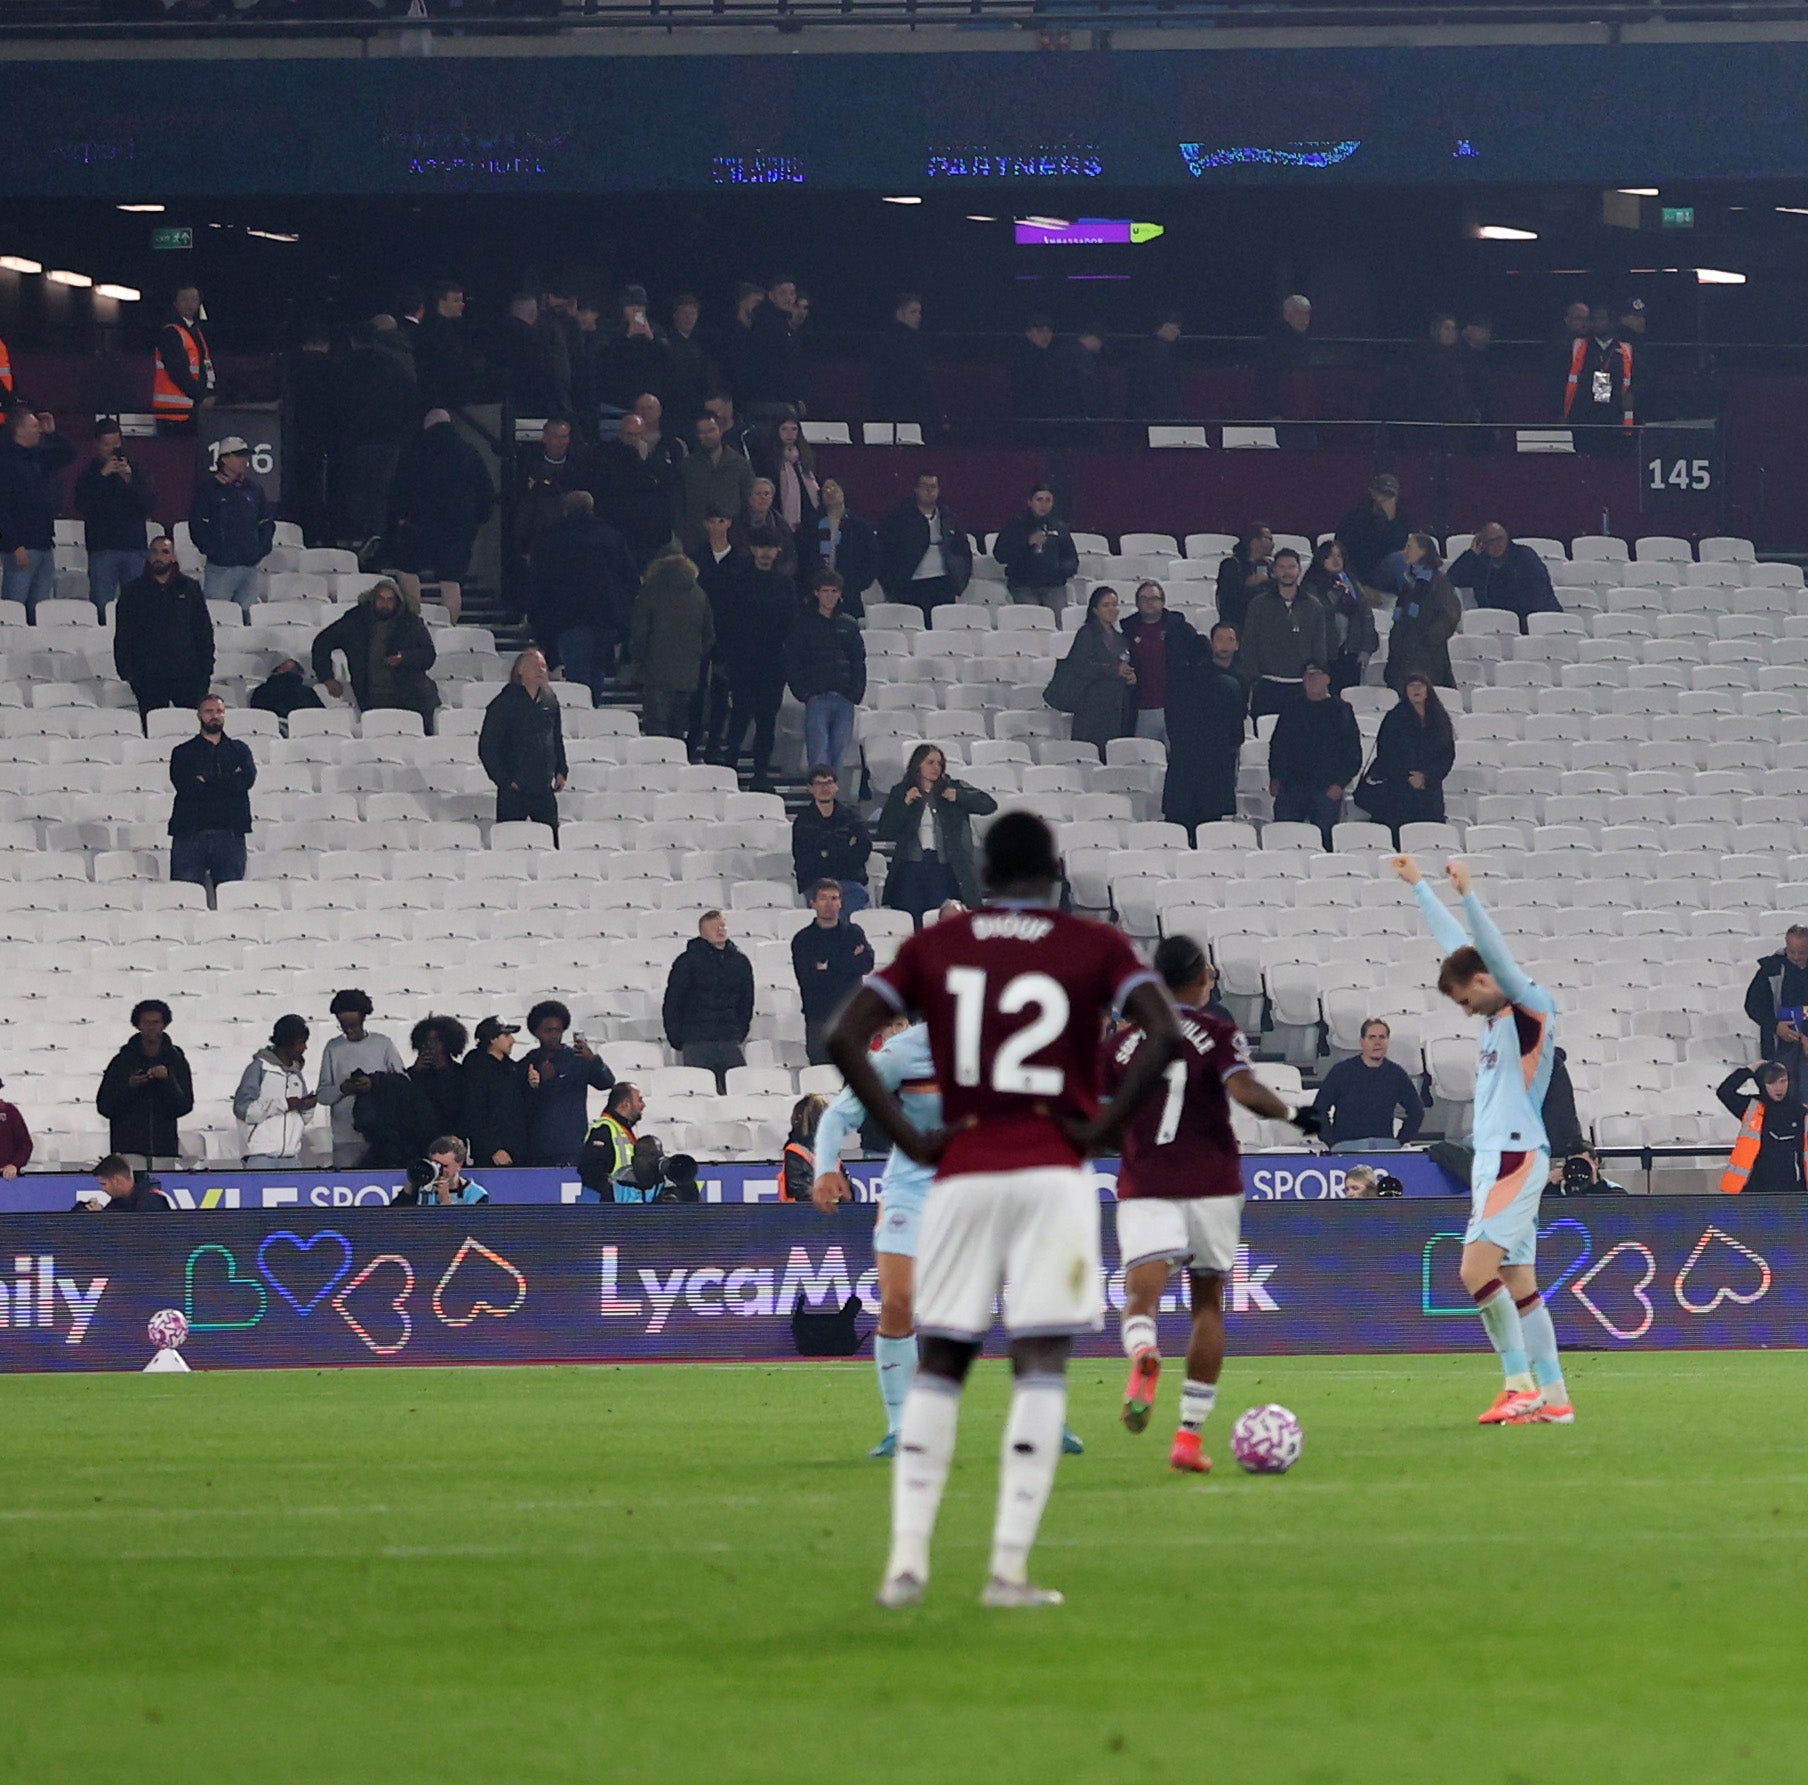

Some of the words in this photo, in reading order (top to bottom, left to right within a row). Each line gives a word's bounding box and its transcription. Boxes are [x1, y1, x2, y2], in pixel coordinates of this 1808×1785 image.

[208, 441, 274, 474] 16
[1648, 458, 1711, 490] 145
[945, 967, 1071, 1096] 12
[1252, 1169, 1390, 1199] SPOR
[0, 1255, 110, 1345] ily
